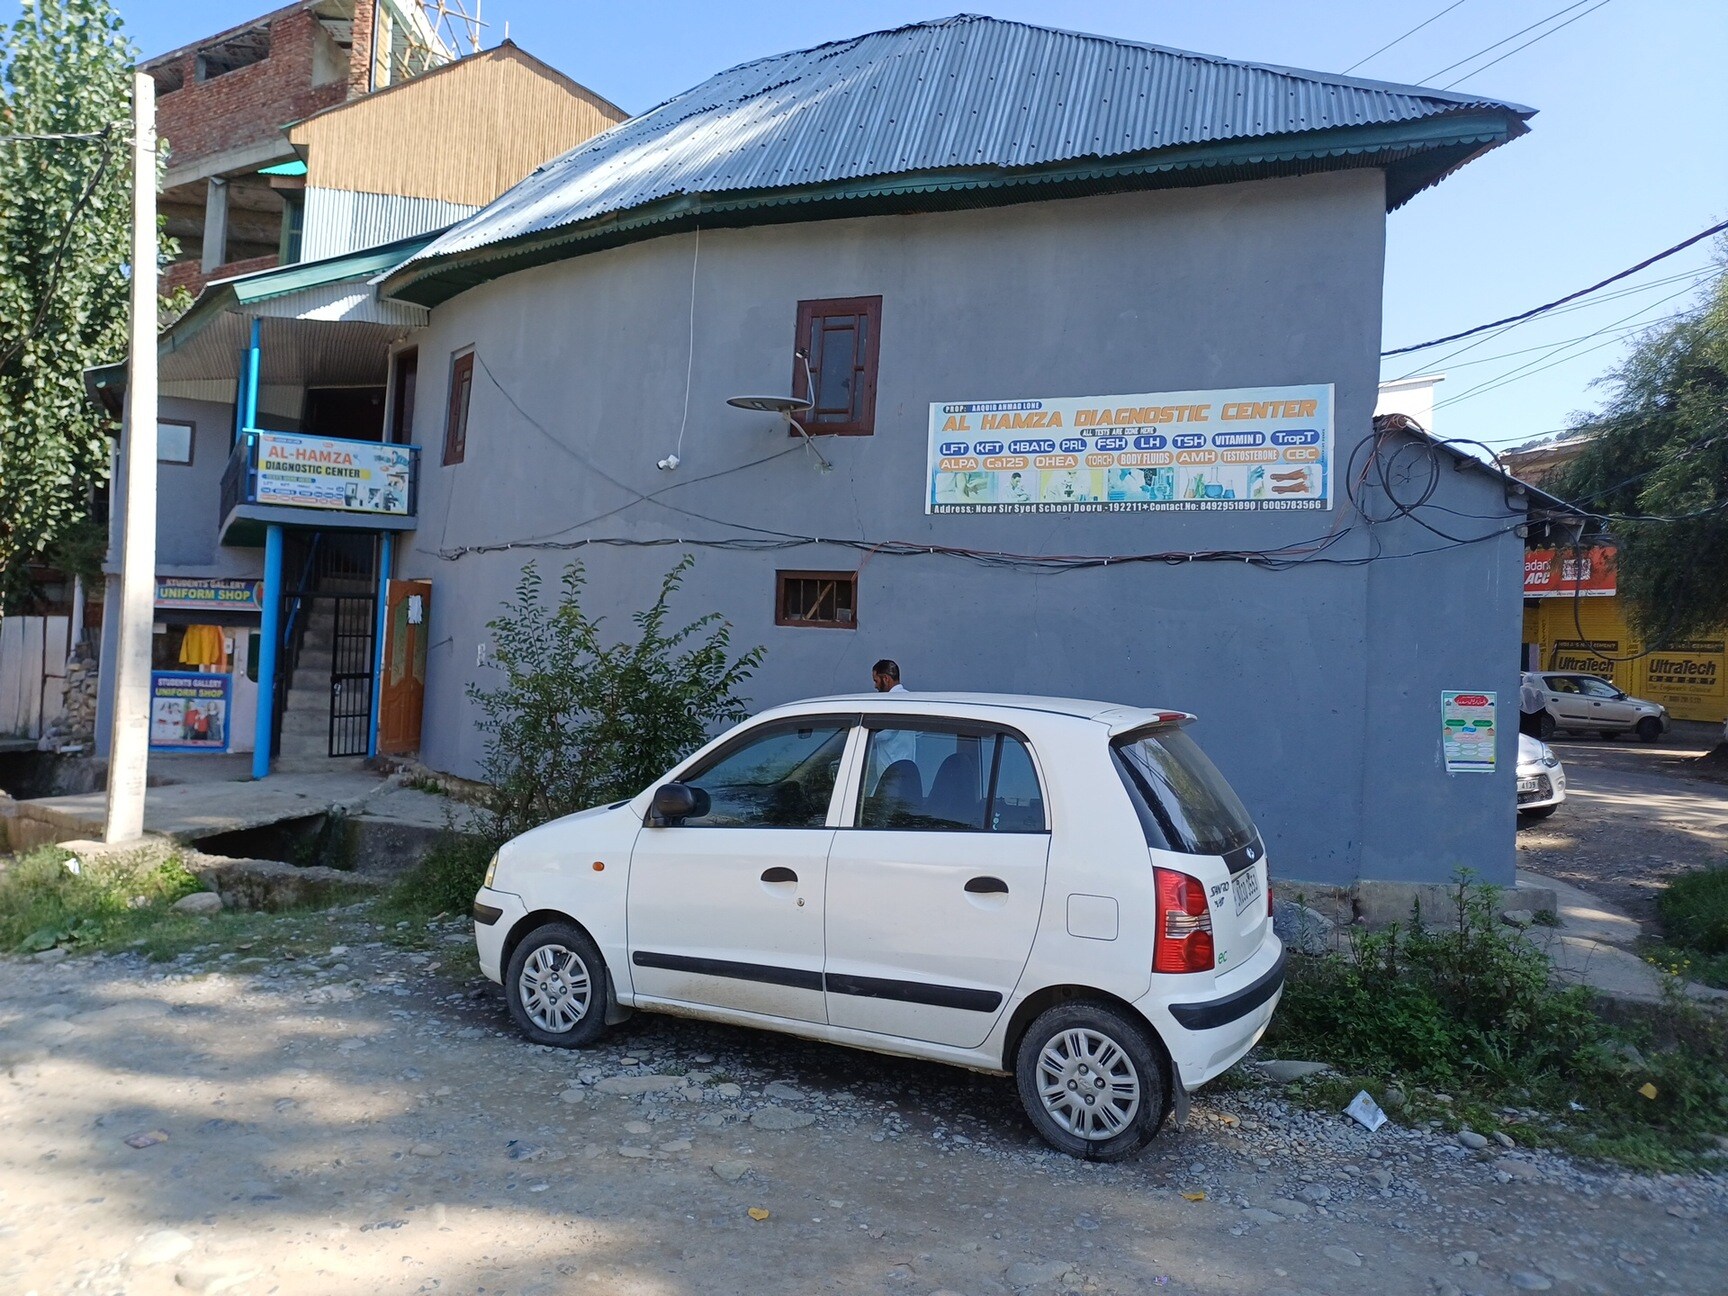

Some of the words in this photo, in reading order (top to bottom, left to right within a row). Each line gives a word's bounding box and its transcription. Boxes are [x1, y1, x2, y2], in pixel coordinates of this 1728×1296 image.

[942, 415, 971, 432] AL
[980, 410, 1063, 431] HAMZA
[1073, 403, 1211, 428] DIAGNOSTIC
[1220, 399, 1317, 421] CENTER
[942, 444, 967, 454] LFT
[976, 442, 1001, 453] KFT
[1010, 441, 1053, 452] HBA1C
[1062, 440, 1085, 450] PRL
[1097, 438, 1126, 448] FSH
[1141, 437, 1160, 448] LH
[1174, 436, 1204, 447] TSH
[1215, 434, 1251, 445] VITAMIN
[1255, 433, 1263, 444] D
[1276, 431, 1315, 445] TropT
[268, 445, 352, 465] AL-HAMZA
[941, 459, 977, 469] ALPA
[986, 457, 1024, 467] Ca125
[1035, 456, 1075, 467] DHEA
[1087, 455, 1112, 465] TORCH
[1121, 453, 1141, 464] BODY
[1143, 452, 1170, 464] FLUIDS
[1178, 451, 1215, 462] AMH
[1223, 450, 1277, 461] TESTOSTERONE
[1286, 448, 1316, 460] CBC
[265, 460, 322, 475] DIAGNOSTIC
[325, 466, 360, 479] CENTER
[934, 504, 974, 514] Address:
[998, 504, 1012, 513] Sir
[1014, 503, 1037, 514] Syed
[1038, 503, 1072, 512] School
[1524, 572, 1551, 585] ACC
[160, 588, 215, 599] UNIFORM
[218, 589, 251, 600] SHOP
[1558, 657, 1615, 673] UltraTech
[1649, 659, 1716, 676] UltraTech
